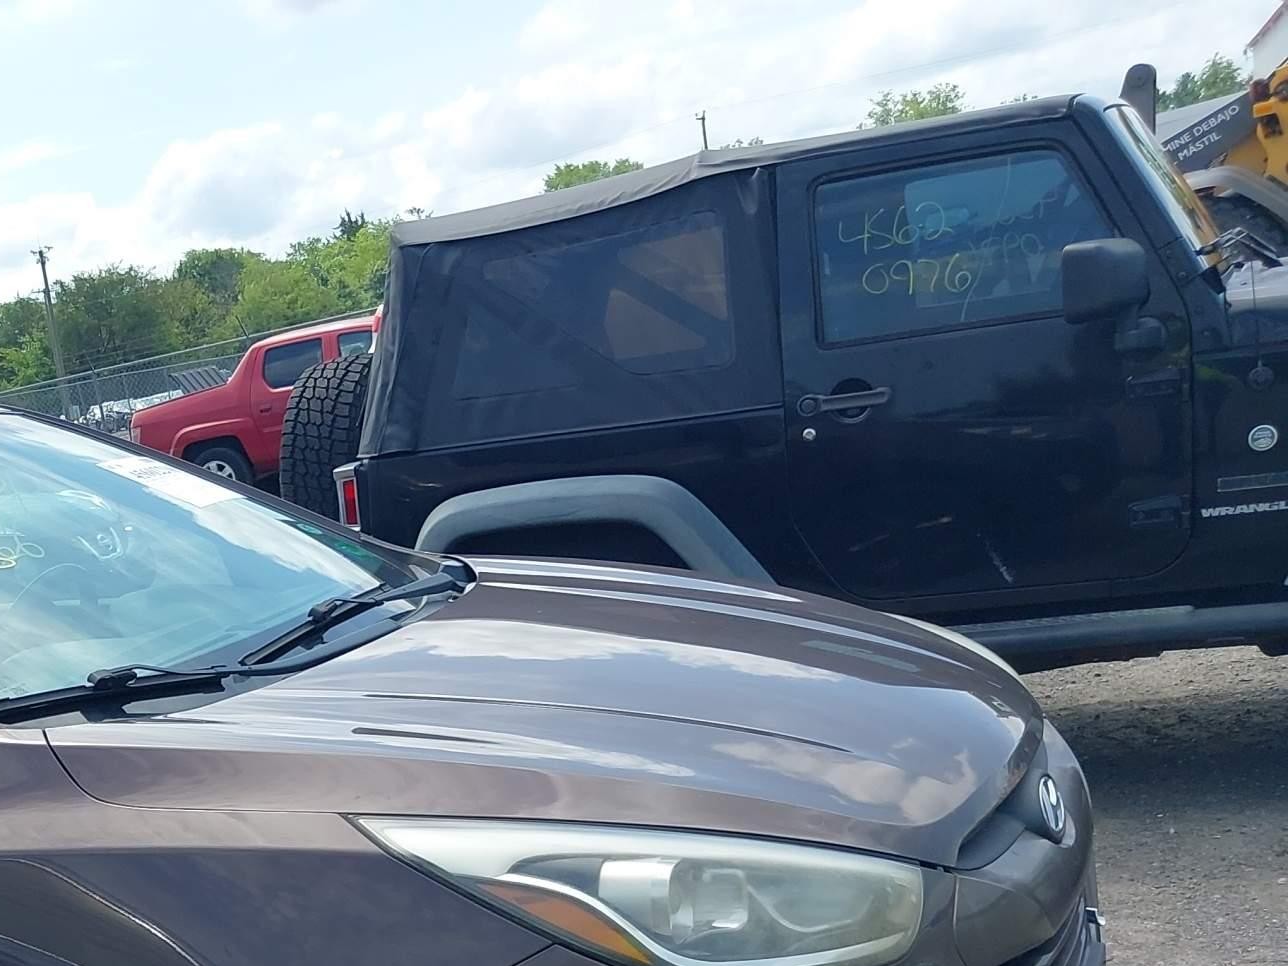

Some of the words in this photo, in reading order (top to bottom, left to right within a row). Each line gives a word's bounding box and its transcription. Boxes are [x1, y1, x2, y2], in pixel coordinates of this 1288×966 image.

[1192, 105, 1240, 137] DEBAJO
[838, 201, 954, 255] 4562
[862, 252, 972, 295] 0976
